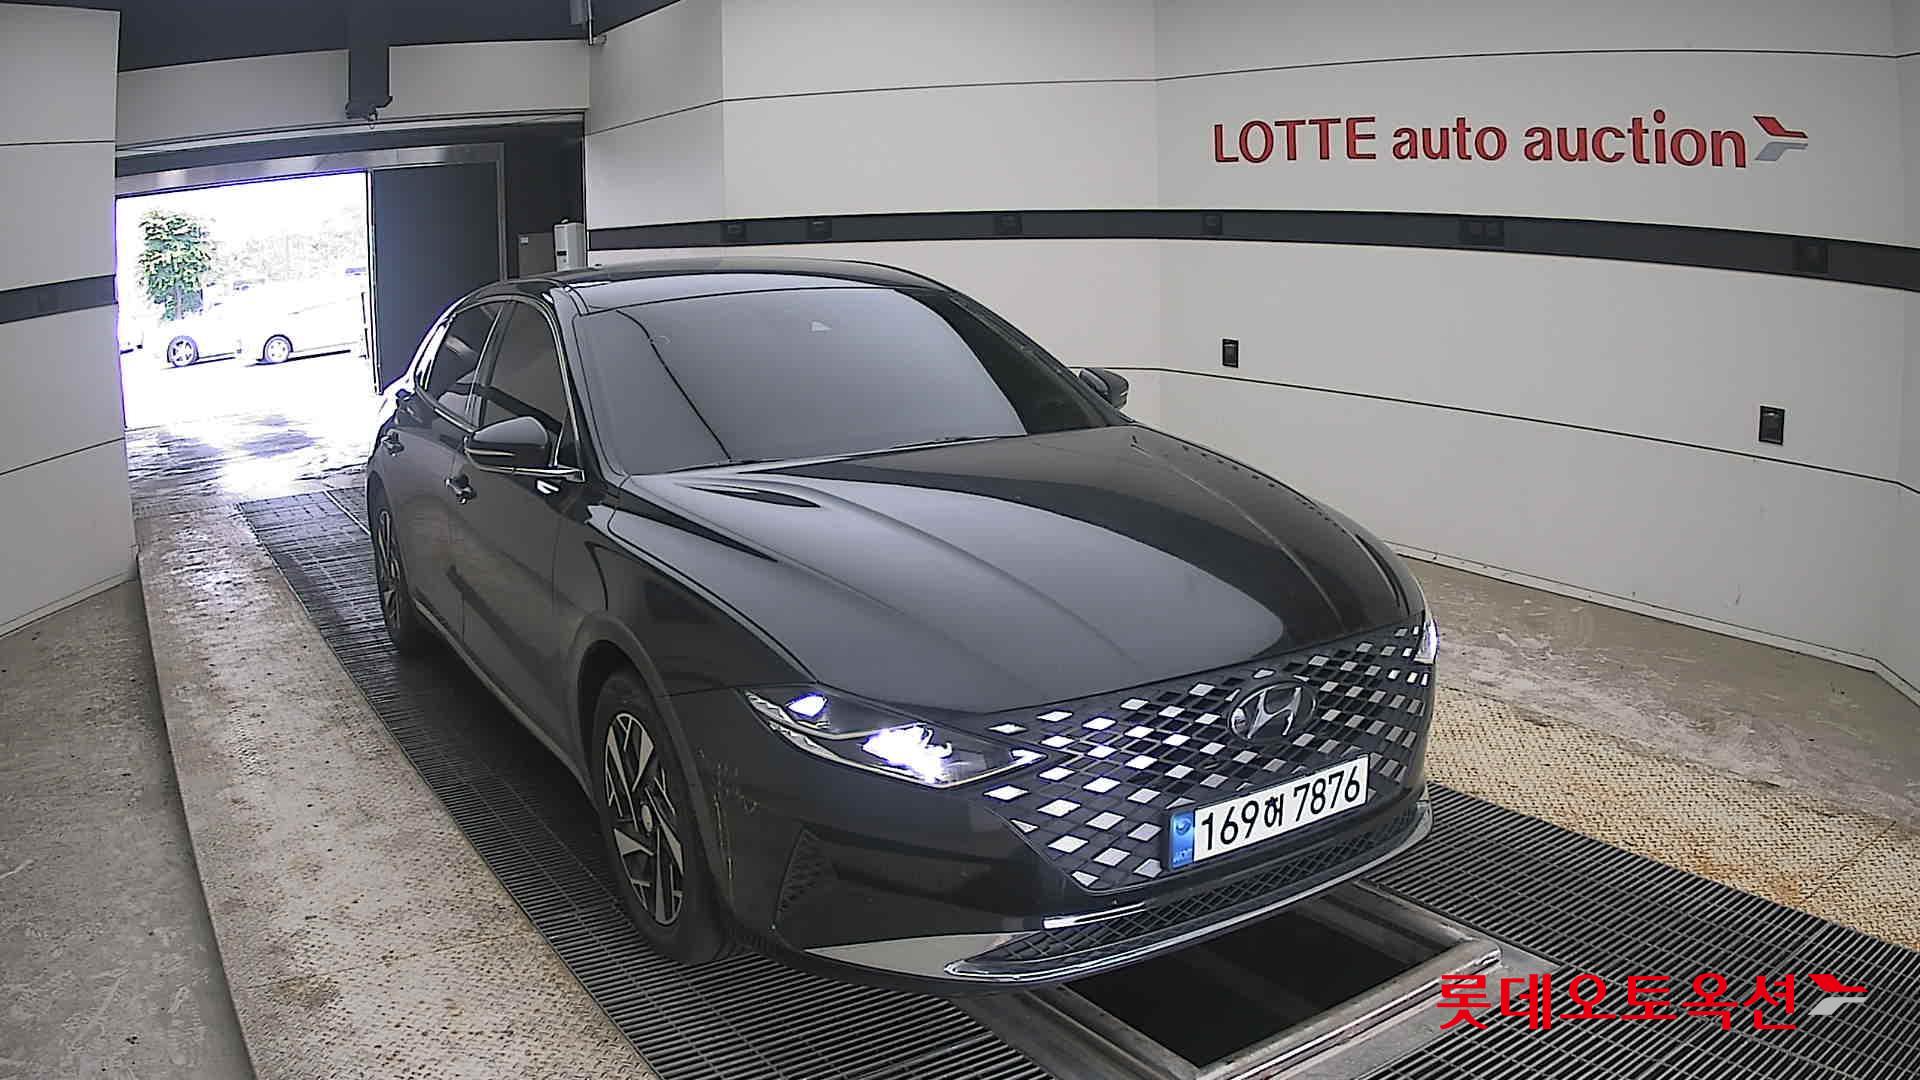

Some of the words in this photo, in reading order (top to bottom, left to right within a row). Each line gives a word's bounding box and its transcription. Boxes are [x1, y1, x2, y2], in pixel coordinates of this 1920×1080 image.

[1213, 116, 1377, 163] LOTTE
[1392, 117, 1507, 161] auto
[1523, 110, 1747, 168] auction
[1294, 766, 1361, 821] 7876
